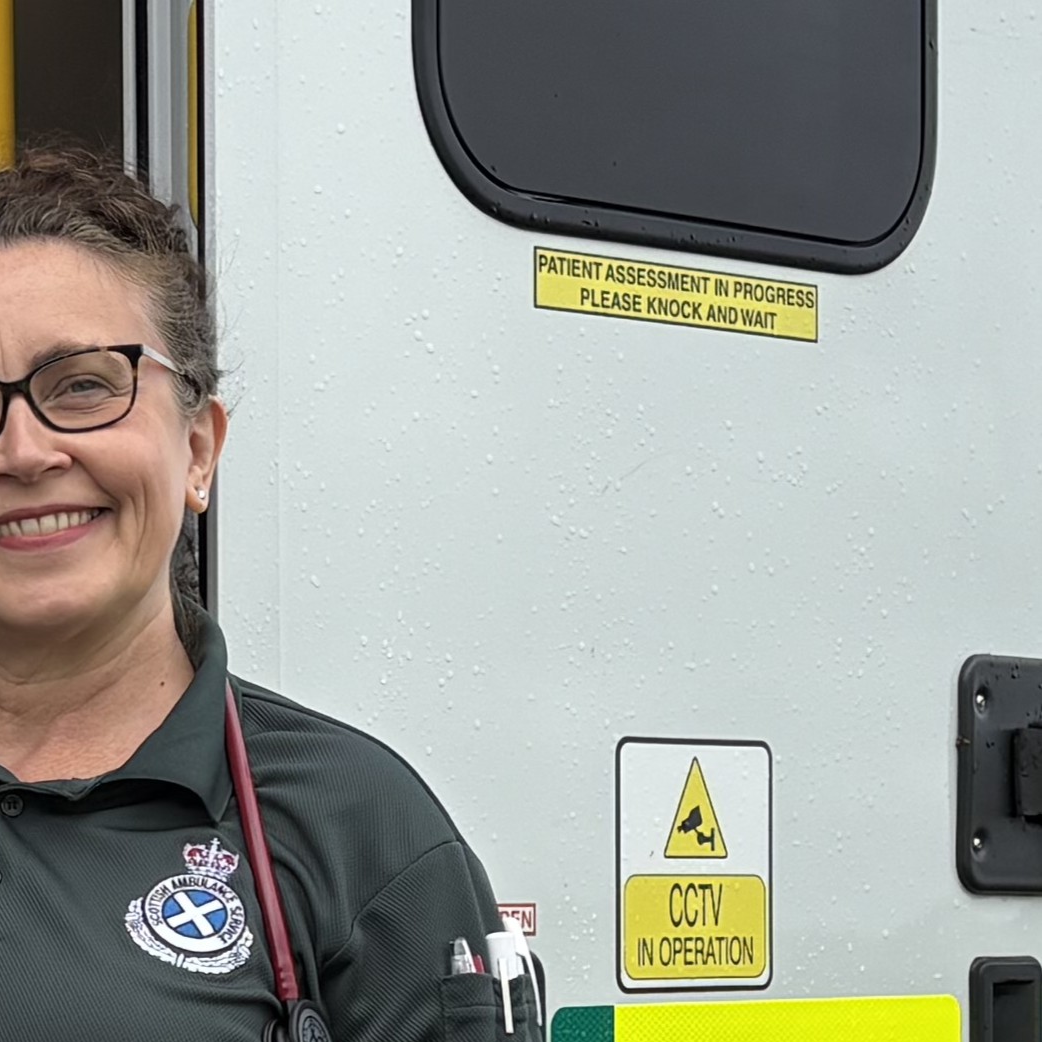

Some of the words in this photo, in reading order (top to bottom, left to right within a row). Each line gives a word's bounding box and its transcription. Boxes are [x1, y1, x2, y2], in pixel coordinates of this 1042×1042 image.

[539, 254, 602, 281] PATIENT
[605, 264, 710, 296] ASSESSMENT
[714, 276, 729, 296] IN
[733, 280, 815, 309] PROGRESS
[580, 288, 642, 313] PLEASE
[647, 296, 702, 321] KNOCK
[706, 304, 738, 325] AND
[740, 308, 777, 331] WAIT
[149, 884, 172, 926] SCOTTISH
[171, 876, 238, 904] AMBULANCE
[217, 906, 244, 944] SERVICE
[669, 882, 723, 928] CCTV
[638, 938, 654, 967] IN
[659, 936, 754, 967] OPERATION
